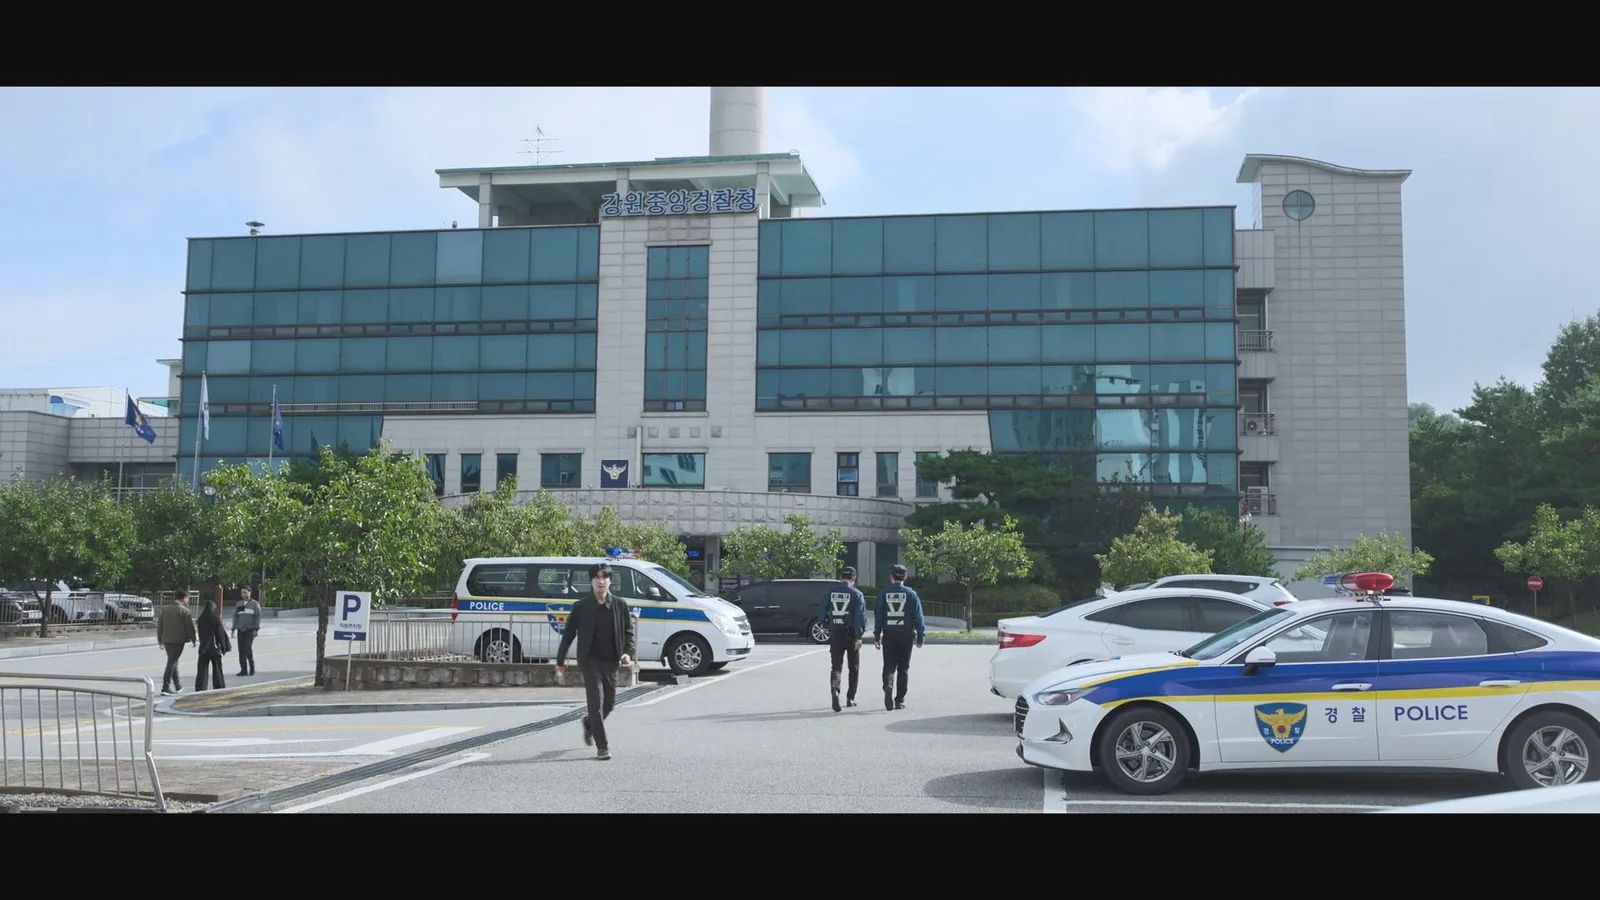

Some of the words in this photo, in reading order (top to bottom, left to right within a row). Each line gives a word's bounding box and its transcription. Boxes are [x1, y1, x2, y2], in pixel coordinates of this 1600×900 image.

[601, 187, 758, 216] 강원중앙경찰청
[342, 594, 361, 620] P
[469, 601, 505, 611] POLICE
[1394, 705, 1468, 721] POLICE
